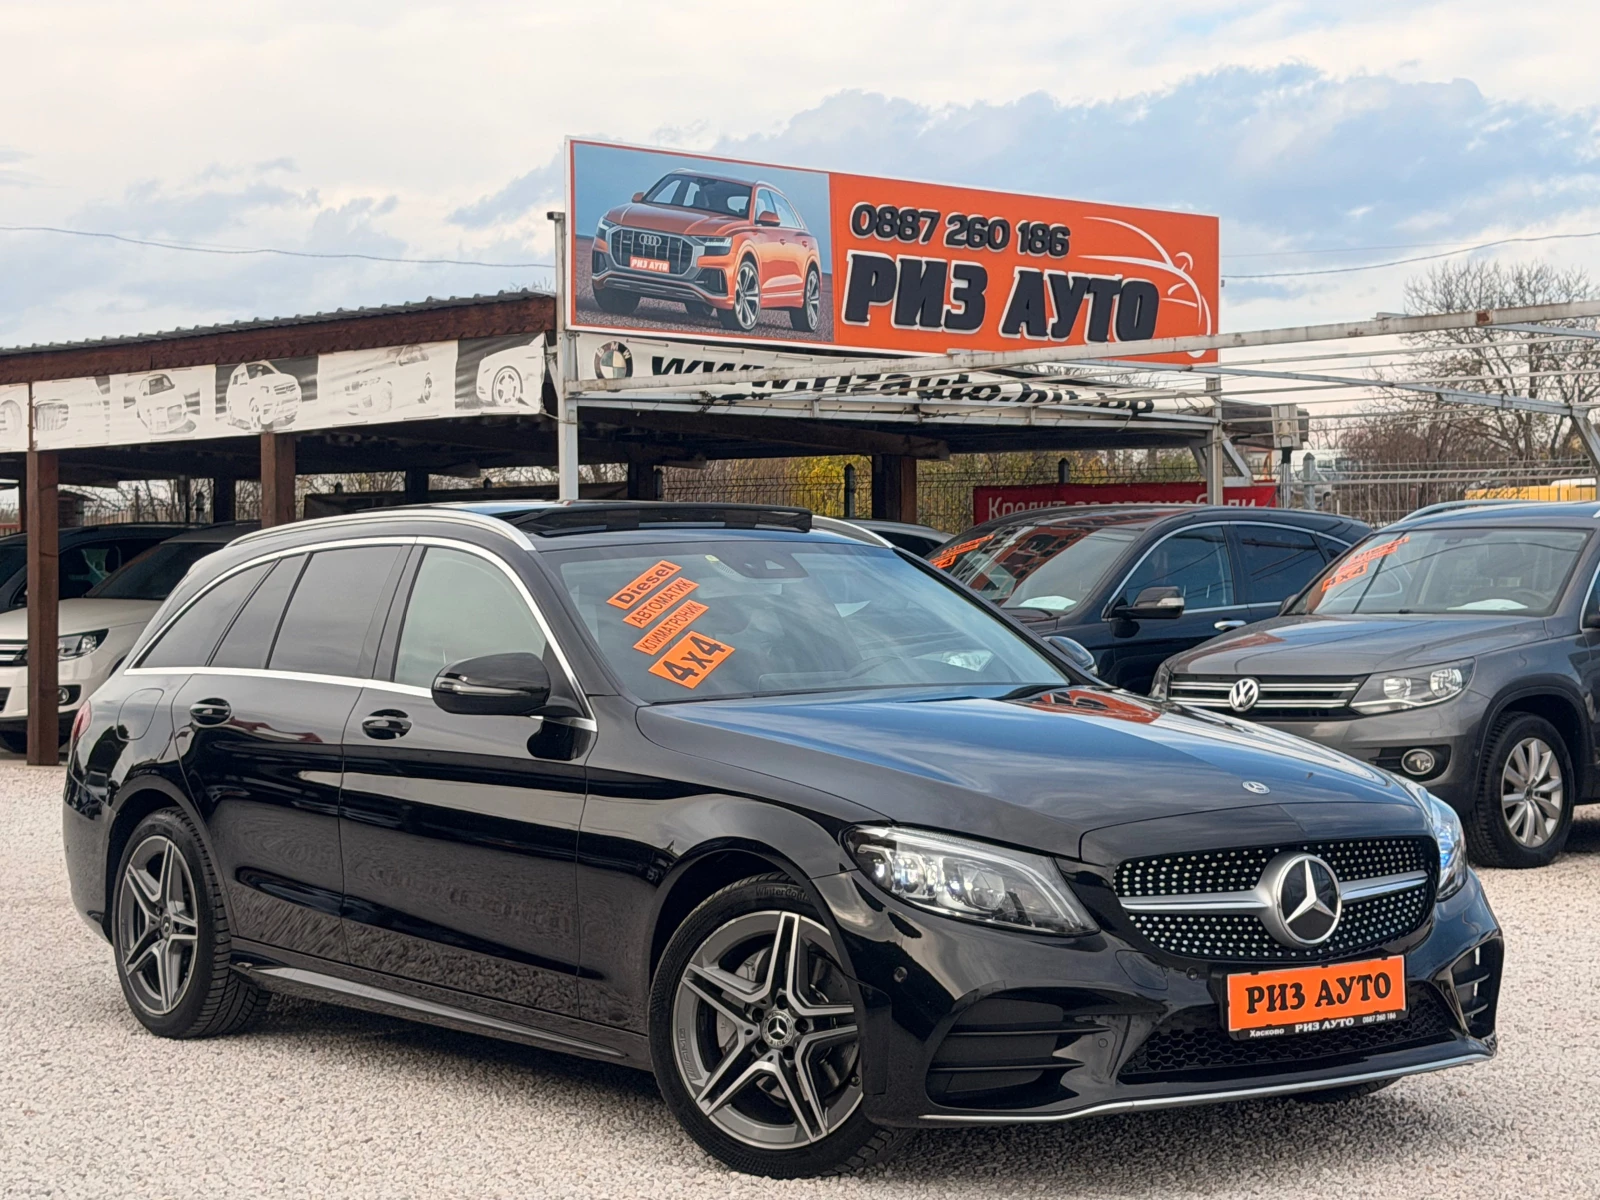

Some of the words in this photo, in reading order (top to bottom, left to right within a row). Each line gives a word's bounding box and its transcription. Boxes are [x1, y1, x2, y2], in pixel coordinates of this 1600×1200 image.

[851, 202, 941, 244] 0887
[944, 212, 1010, 251] 260
[1016, 220, 1071, 257] 186
[841, 249, 988, 334] РИЗ
[999, 266, 1160, 343] АУТО
[615, 563, 675, 604] Diesel
[631, 579, 692, 625] АВТОМАТИК
[640, 602, 702, 651] КЛИМАТРОНИК
[663, 636, 726, 681] 4x4
[1245, 982, 1305, 1014] РИЗ
[1315, 972, 1391, 1007] АУТО
[1250, 1028, 1284, 1038] Хасково
[1295, 1021, 1320, 1033] РИЗ
[1322, 1017, 1354, 1030] АУТО
